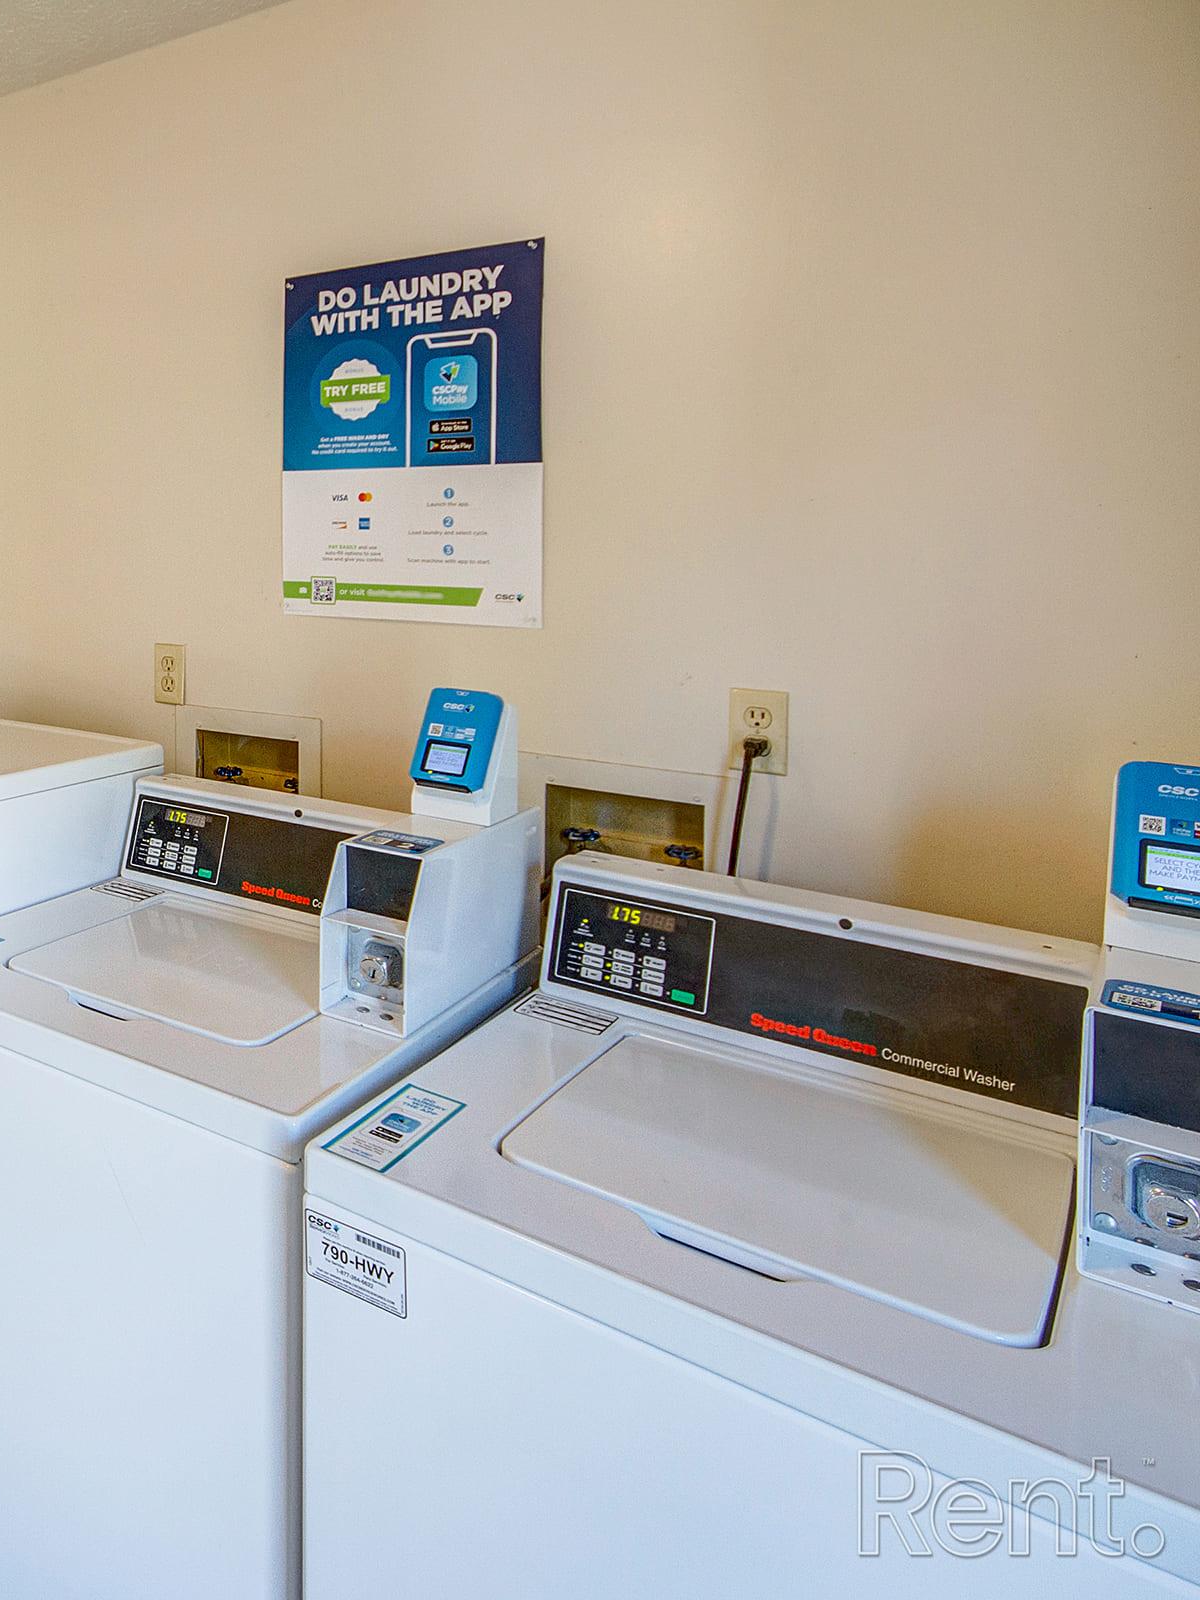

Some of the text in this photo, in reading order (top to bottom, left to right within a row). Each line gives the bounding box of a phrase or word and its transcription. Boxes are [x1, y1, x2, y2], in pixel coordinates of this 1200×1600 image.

[318, 265, 504, 313] DO LAUNDRY
[311, 291, 512, 337] WITH THE APP
[324, 382, 386, 398] TRY FREE
[432, 385, 468, 394] CSCPay
[432, 395, 467, 405] Mobile
[440, 425, 453, 433] App
[440, 442, 472, 451] Google Play
[332, 494, 348, 502] VISA
[350, 588, 366, 597] visit
[495, 593, 515, 601] CSC
[443, 702, 465, 711] CSC
[1157, 785, 1199, 796] CSC
[1154, 857, 1200, 869] SELECT CY
[1150, 869, 1174, 878] MAKE
[1161, 865, 1182, 873] AND
[241, 881, 275, 897] Speed
[276, 888, 310, 905] Queen
[751, 1012, 1016, 1093] Speed Queen Commercial Washer
[308, 1214, 332, 1230] CSC
[321, 1239, 394, 1284] 790-HWY
